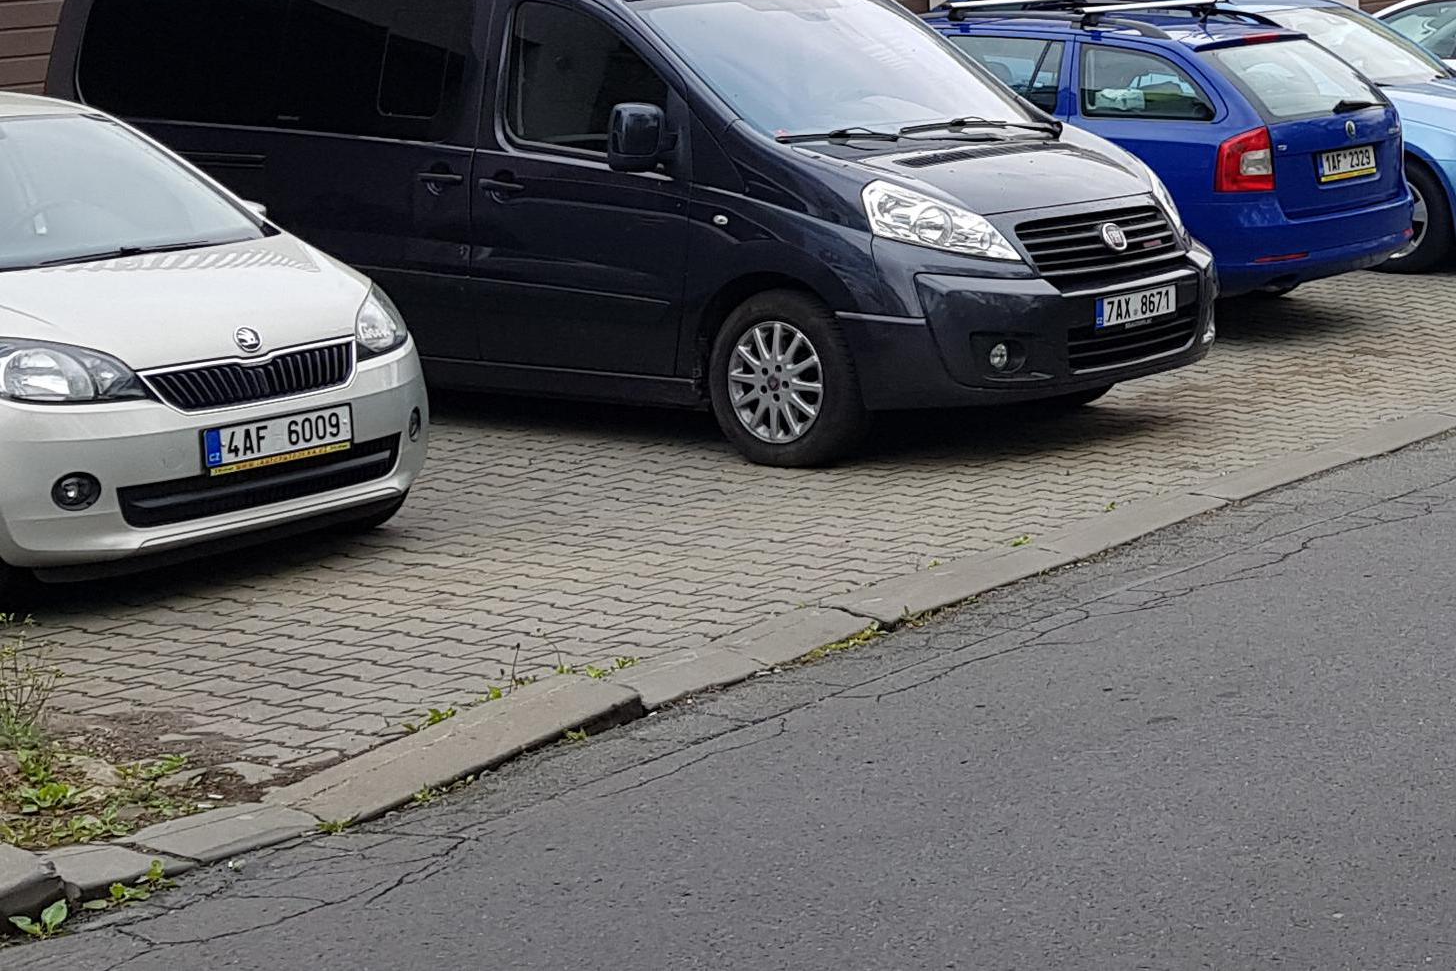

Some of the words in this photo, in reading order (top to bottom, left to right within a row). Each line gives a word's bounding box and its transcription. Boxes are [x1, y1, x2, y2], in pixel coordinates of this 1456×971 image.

[1326, 153, 1342, 172] 1AF
[1349, 149, 1371, 168] 2329
[1107, 297, 1131, 322] 7AX
[1141, 289, 1170, 315] 8671
[208, 452, 220, 461] CZ
[227, 425, 268, 457] 4AF
[287, 412, 340, 446] 6009
